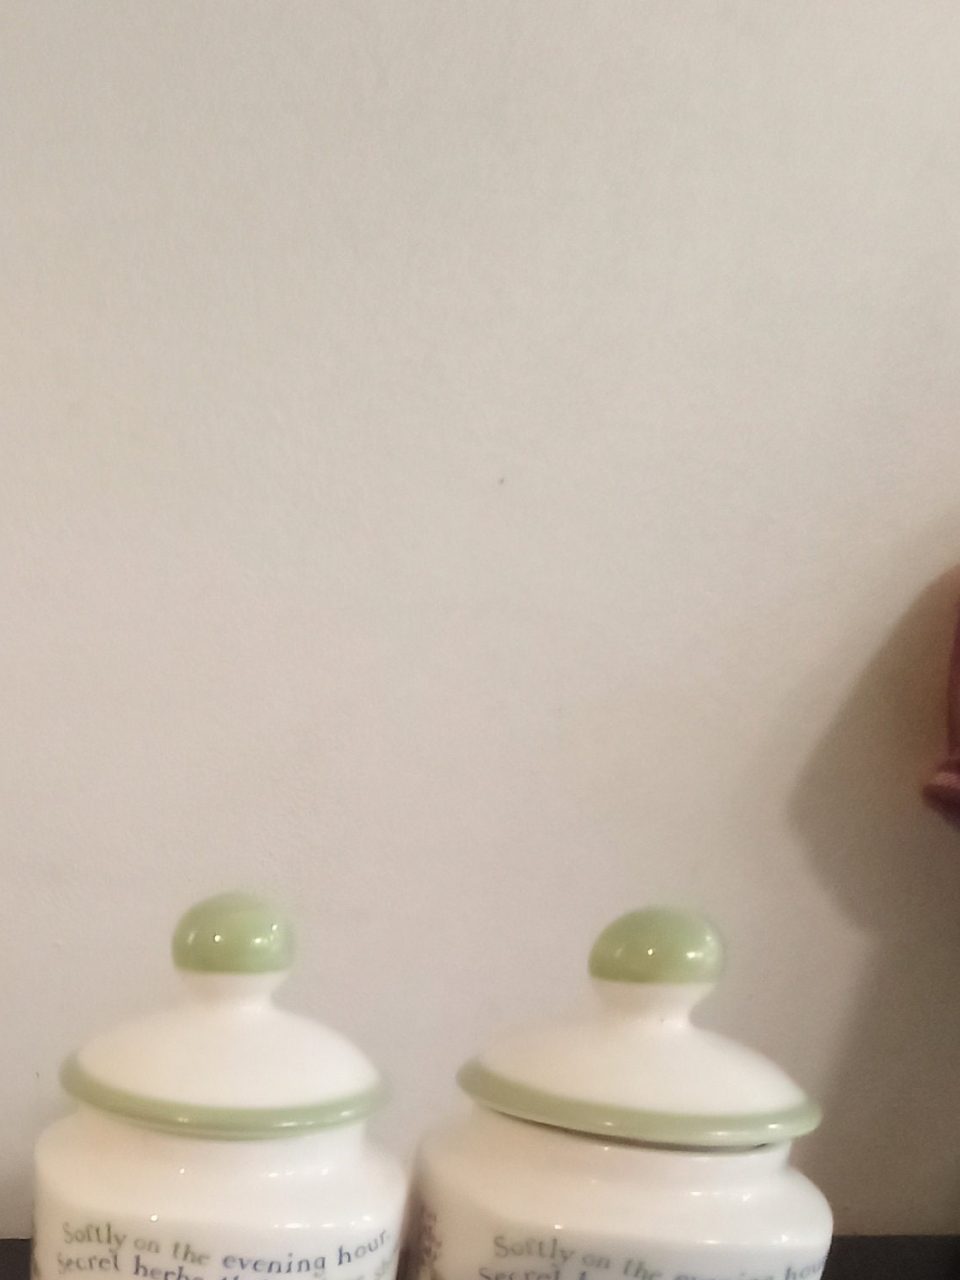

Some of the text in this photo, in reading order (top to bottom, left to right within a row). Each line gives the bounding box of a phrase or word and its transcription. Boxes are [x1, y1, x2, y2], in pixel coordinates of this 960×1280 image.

[57, 1252, 120, 1275] Secret
[62, 1221, 127, 1253] Softly
[133, 1238, 160, 1254] on
[172, 1241, 210, 1265] the
[221, 1252, 327, 1279] evening
[493, 1235, 575, 1268] Softly
[582, 1252, 610, 1270] on
